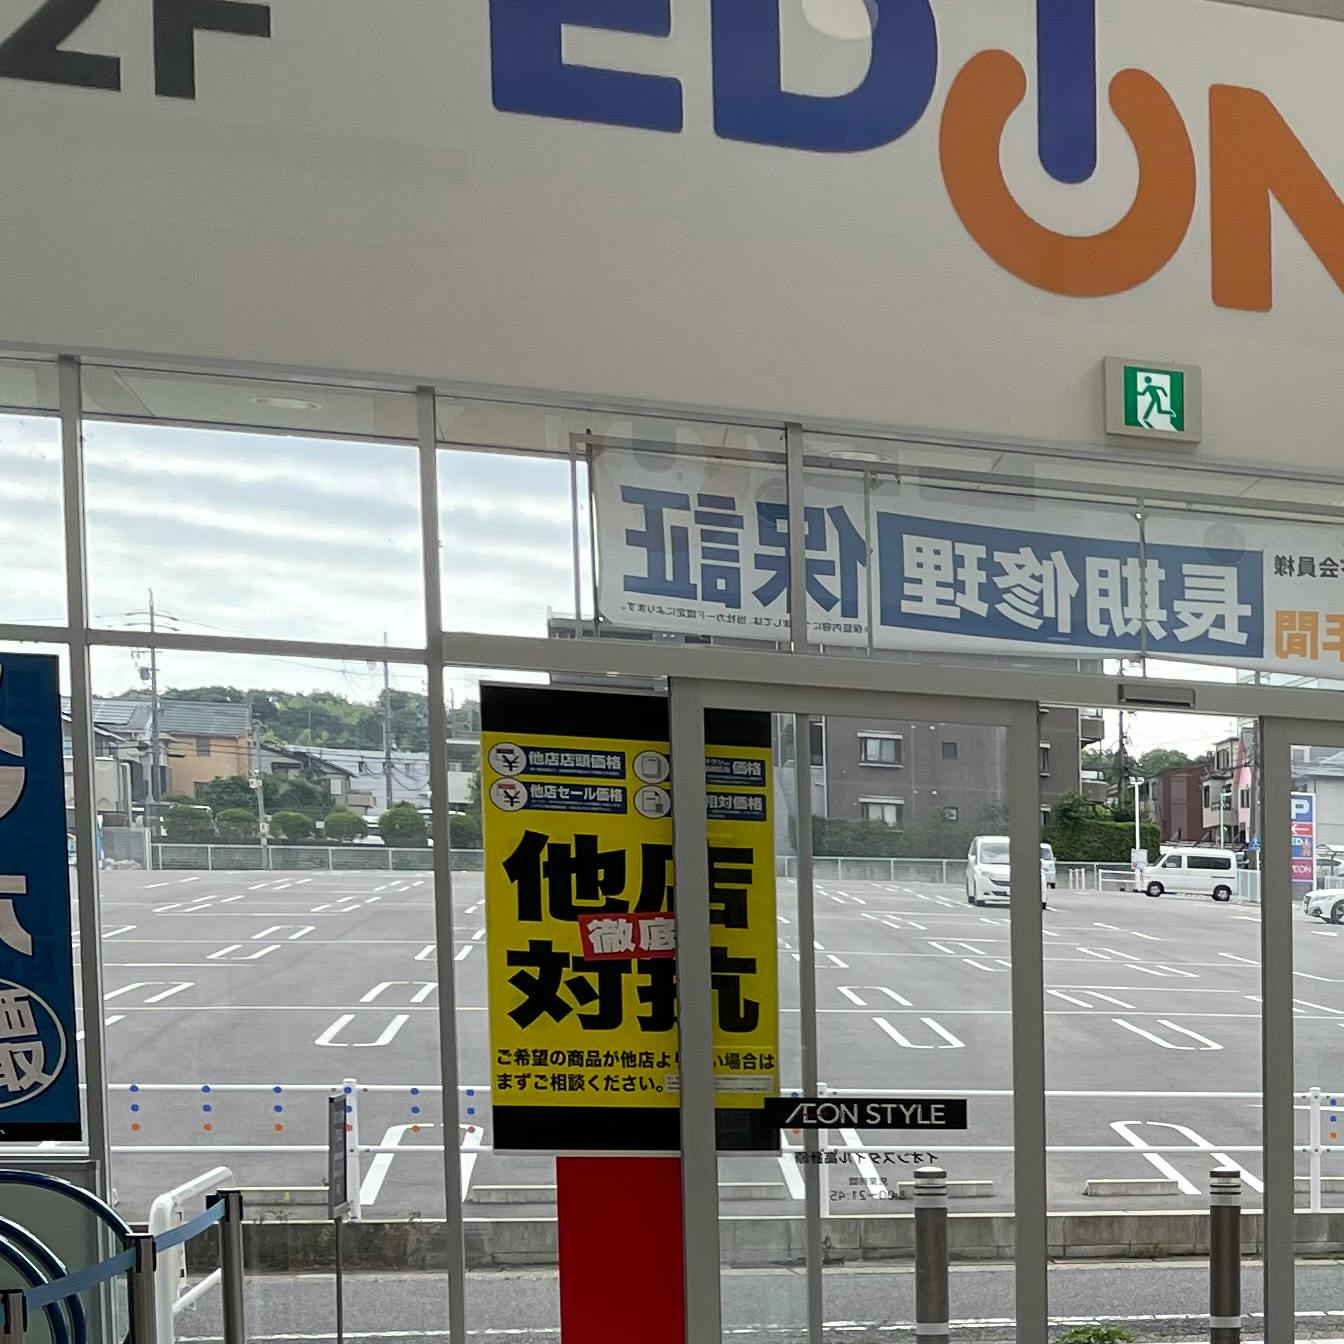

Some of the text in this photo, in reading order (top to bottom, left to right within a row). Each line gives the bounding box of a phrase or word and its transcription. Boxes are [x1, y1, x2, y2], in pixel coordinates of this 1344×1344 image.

[528, 751, 622, 770] 他店店頭価格
[529, 784, 623, 803] 他店セール価格
[496, 1073, 664, 1093] まずご相談ください。
[866, 1103, 946, 1124] STYLE
